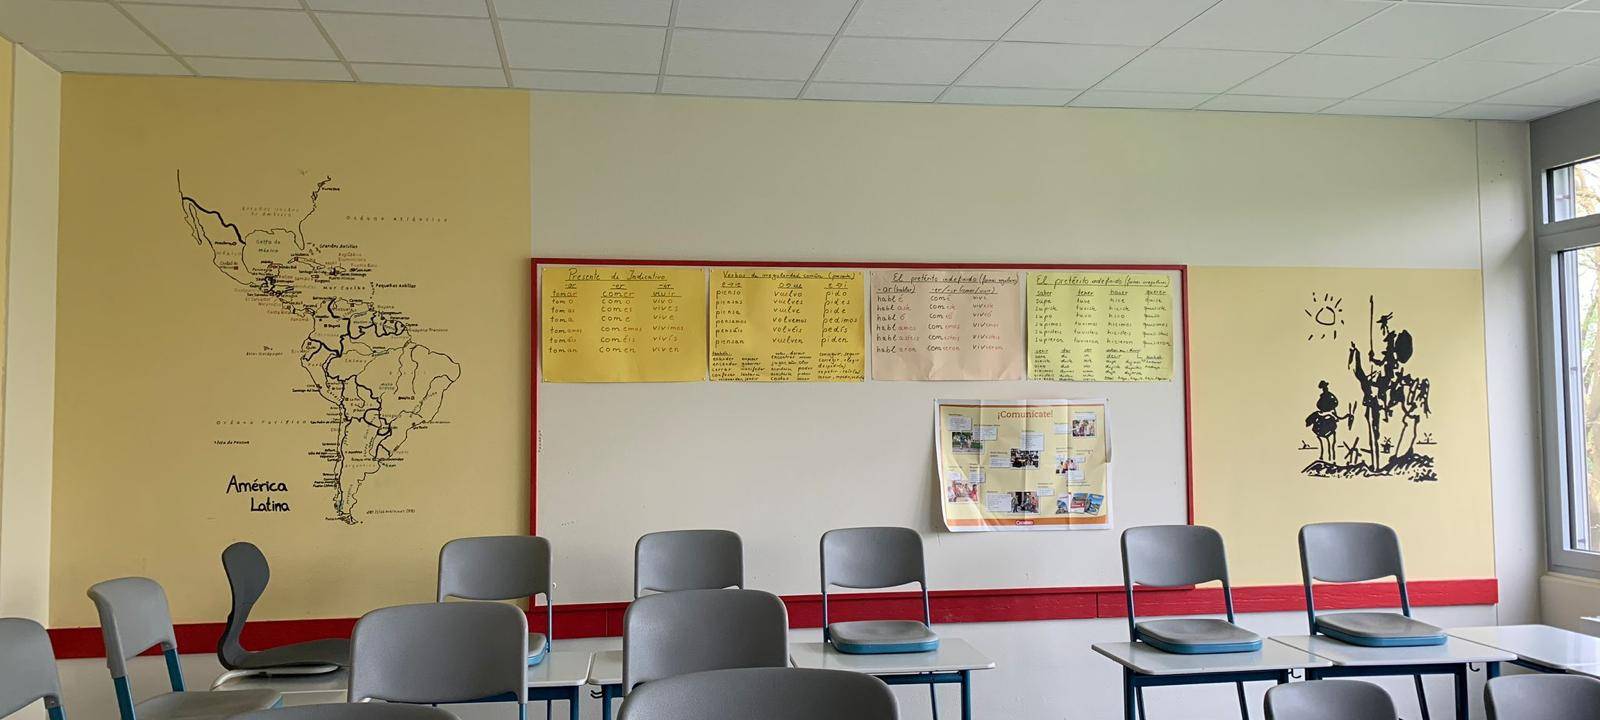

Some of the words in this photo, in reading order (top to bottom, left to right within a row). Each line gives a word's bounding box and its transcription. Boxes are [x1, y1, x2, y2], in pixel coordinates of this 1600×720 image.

[568, 267, 600, 281] Presente
[627, 269, 666, 281] Indicativo
[723, 271, 746, 279] Verbos
[892, 272, 903, 281] El
[1037, 275, 1048, 285] El
[1035, 298, 1051, 306] supe
[821, 336, 849, 347] piden
[997, 409, 1053, 420] ¡Comunícate!
[226, 475, 288, 494] América
[251, 497, 290, 512] Latina
